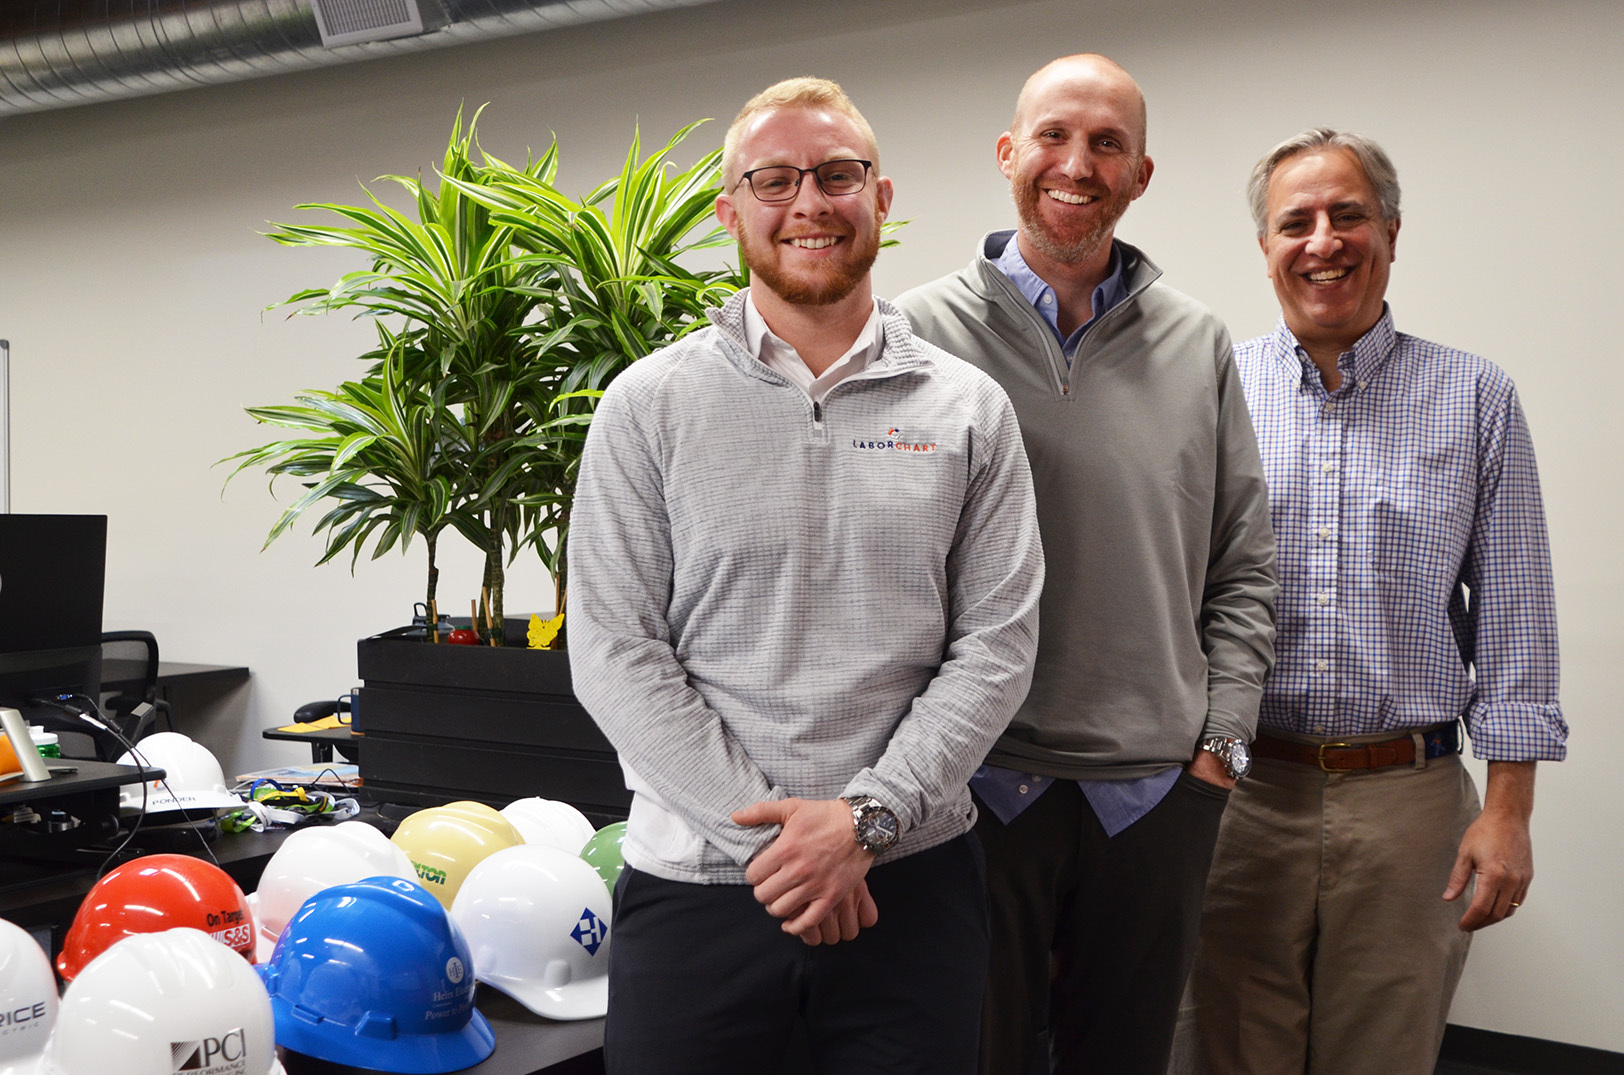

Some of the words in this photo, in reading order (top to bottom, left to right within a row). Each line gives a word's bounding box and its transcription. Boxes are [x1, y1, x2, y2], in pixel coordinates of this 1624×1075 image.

[853, 440, 936, 452] LABORCHART
[152, 797, 196, 805] PONDER
[207, 913, 221, 927] On
[203, 1028, 246, 1067] PCI
